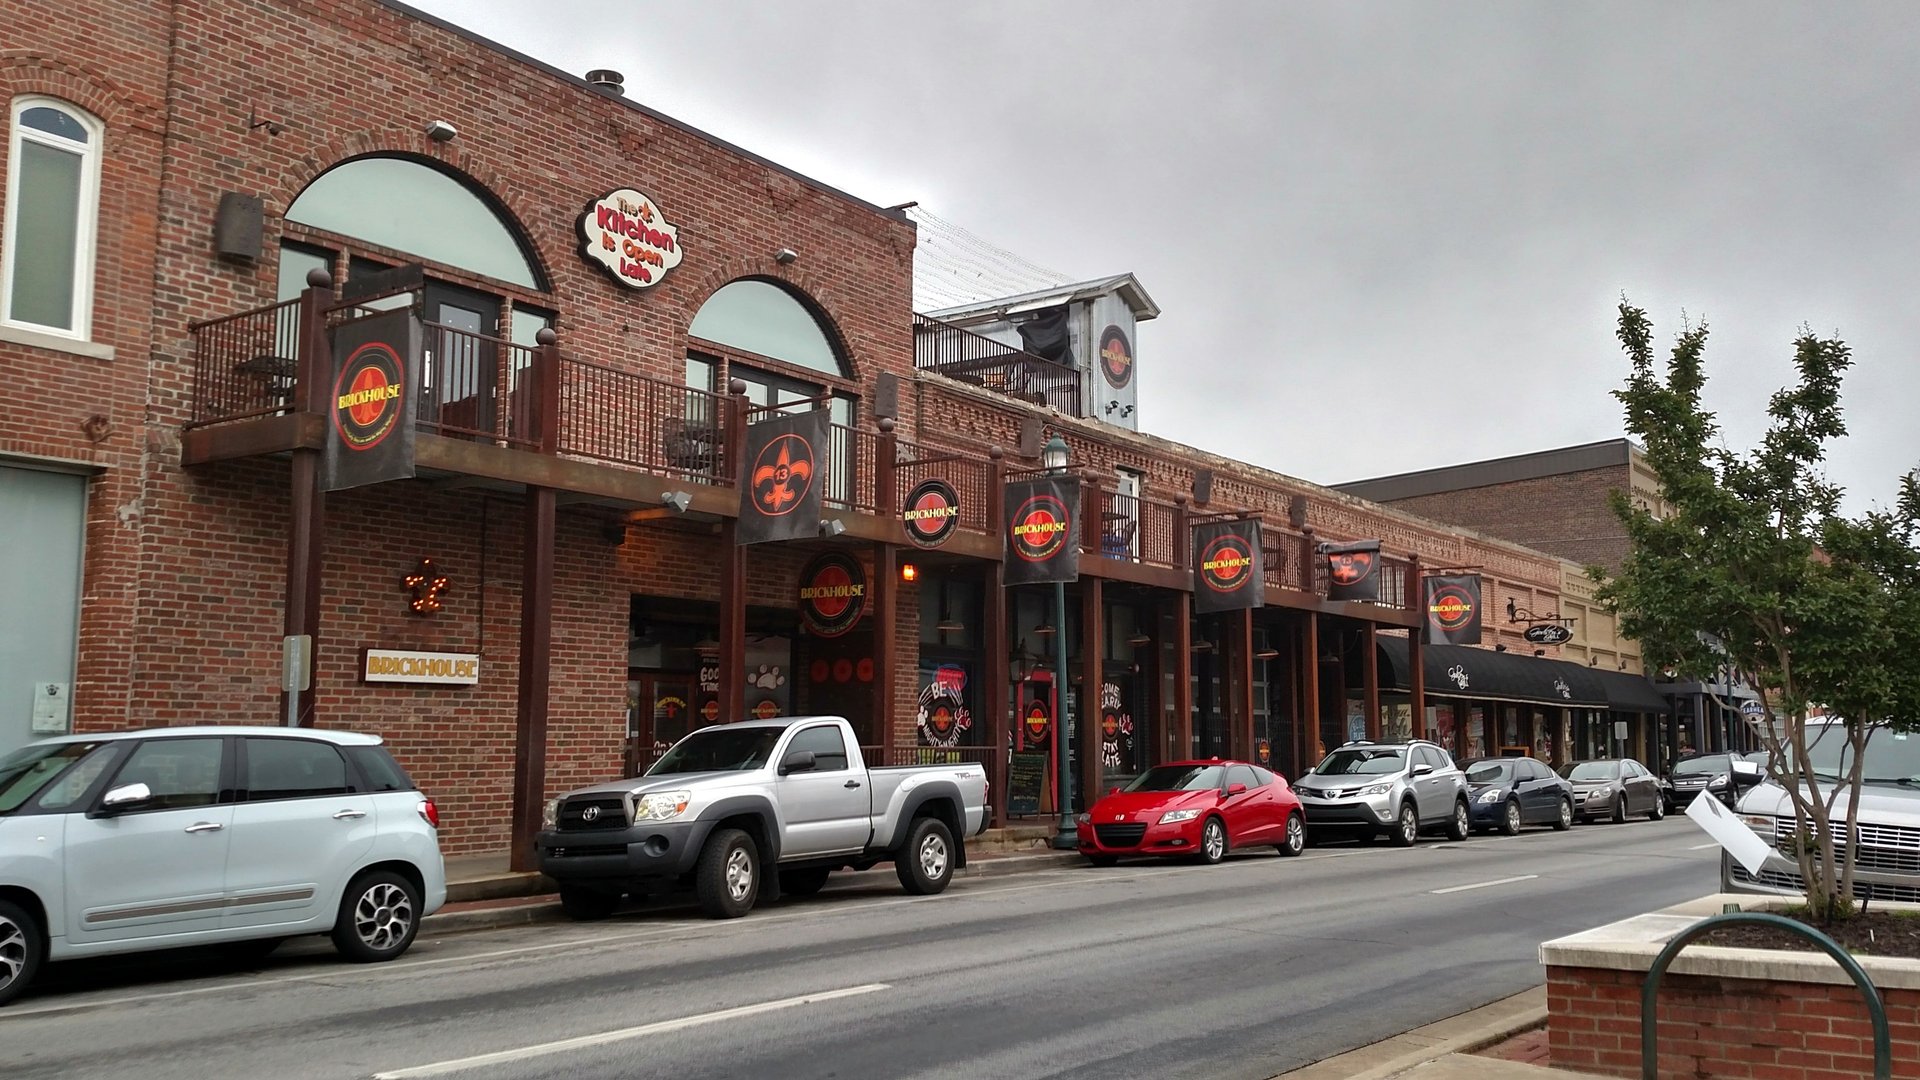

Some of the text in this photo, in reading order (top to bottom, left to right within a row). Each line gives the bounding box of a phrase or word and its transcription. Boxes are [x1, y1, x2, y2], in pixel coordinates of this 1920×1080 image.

[617, 197, 638, 217] The
[597, 204, 675, 254] Kitchen
[602, 231, 663, 269] Is Open
[620, 256, 652, 284] Late
[338, 384, 401, 410] BRICKHOUSE
[775, 468, 788, 481] 13
[904, 505, 959, 521] BRICKHOUSE
[1014, 522, 1066, 536] BRICKHOUSE
[1203, 557, 1251, 571] BRICKHOUSE
[800, 584, 864, 599] BRICKHOUSE
[367, 656, 478, 678] BRICKHOUSE
[700, 667, 719, 681] GOO
[931, 681, 948, 700] BE
